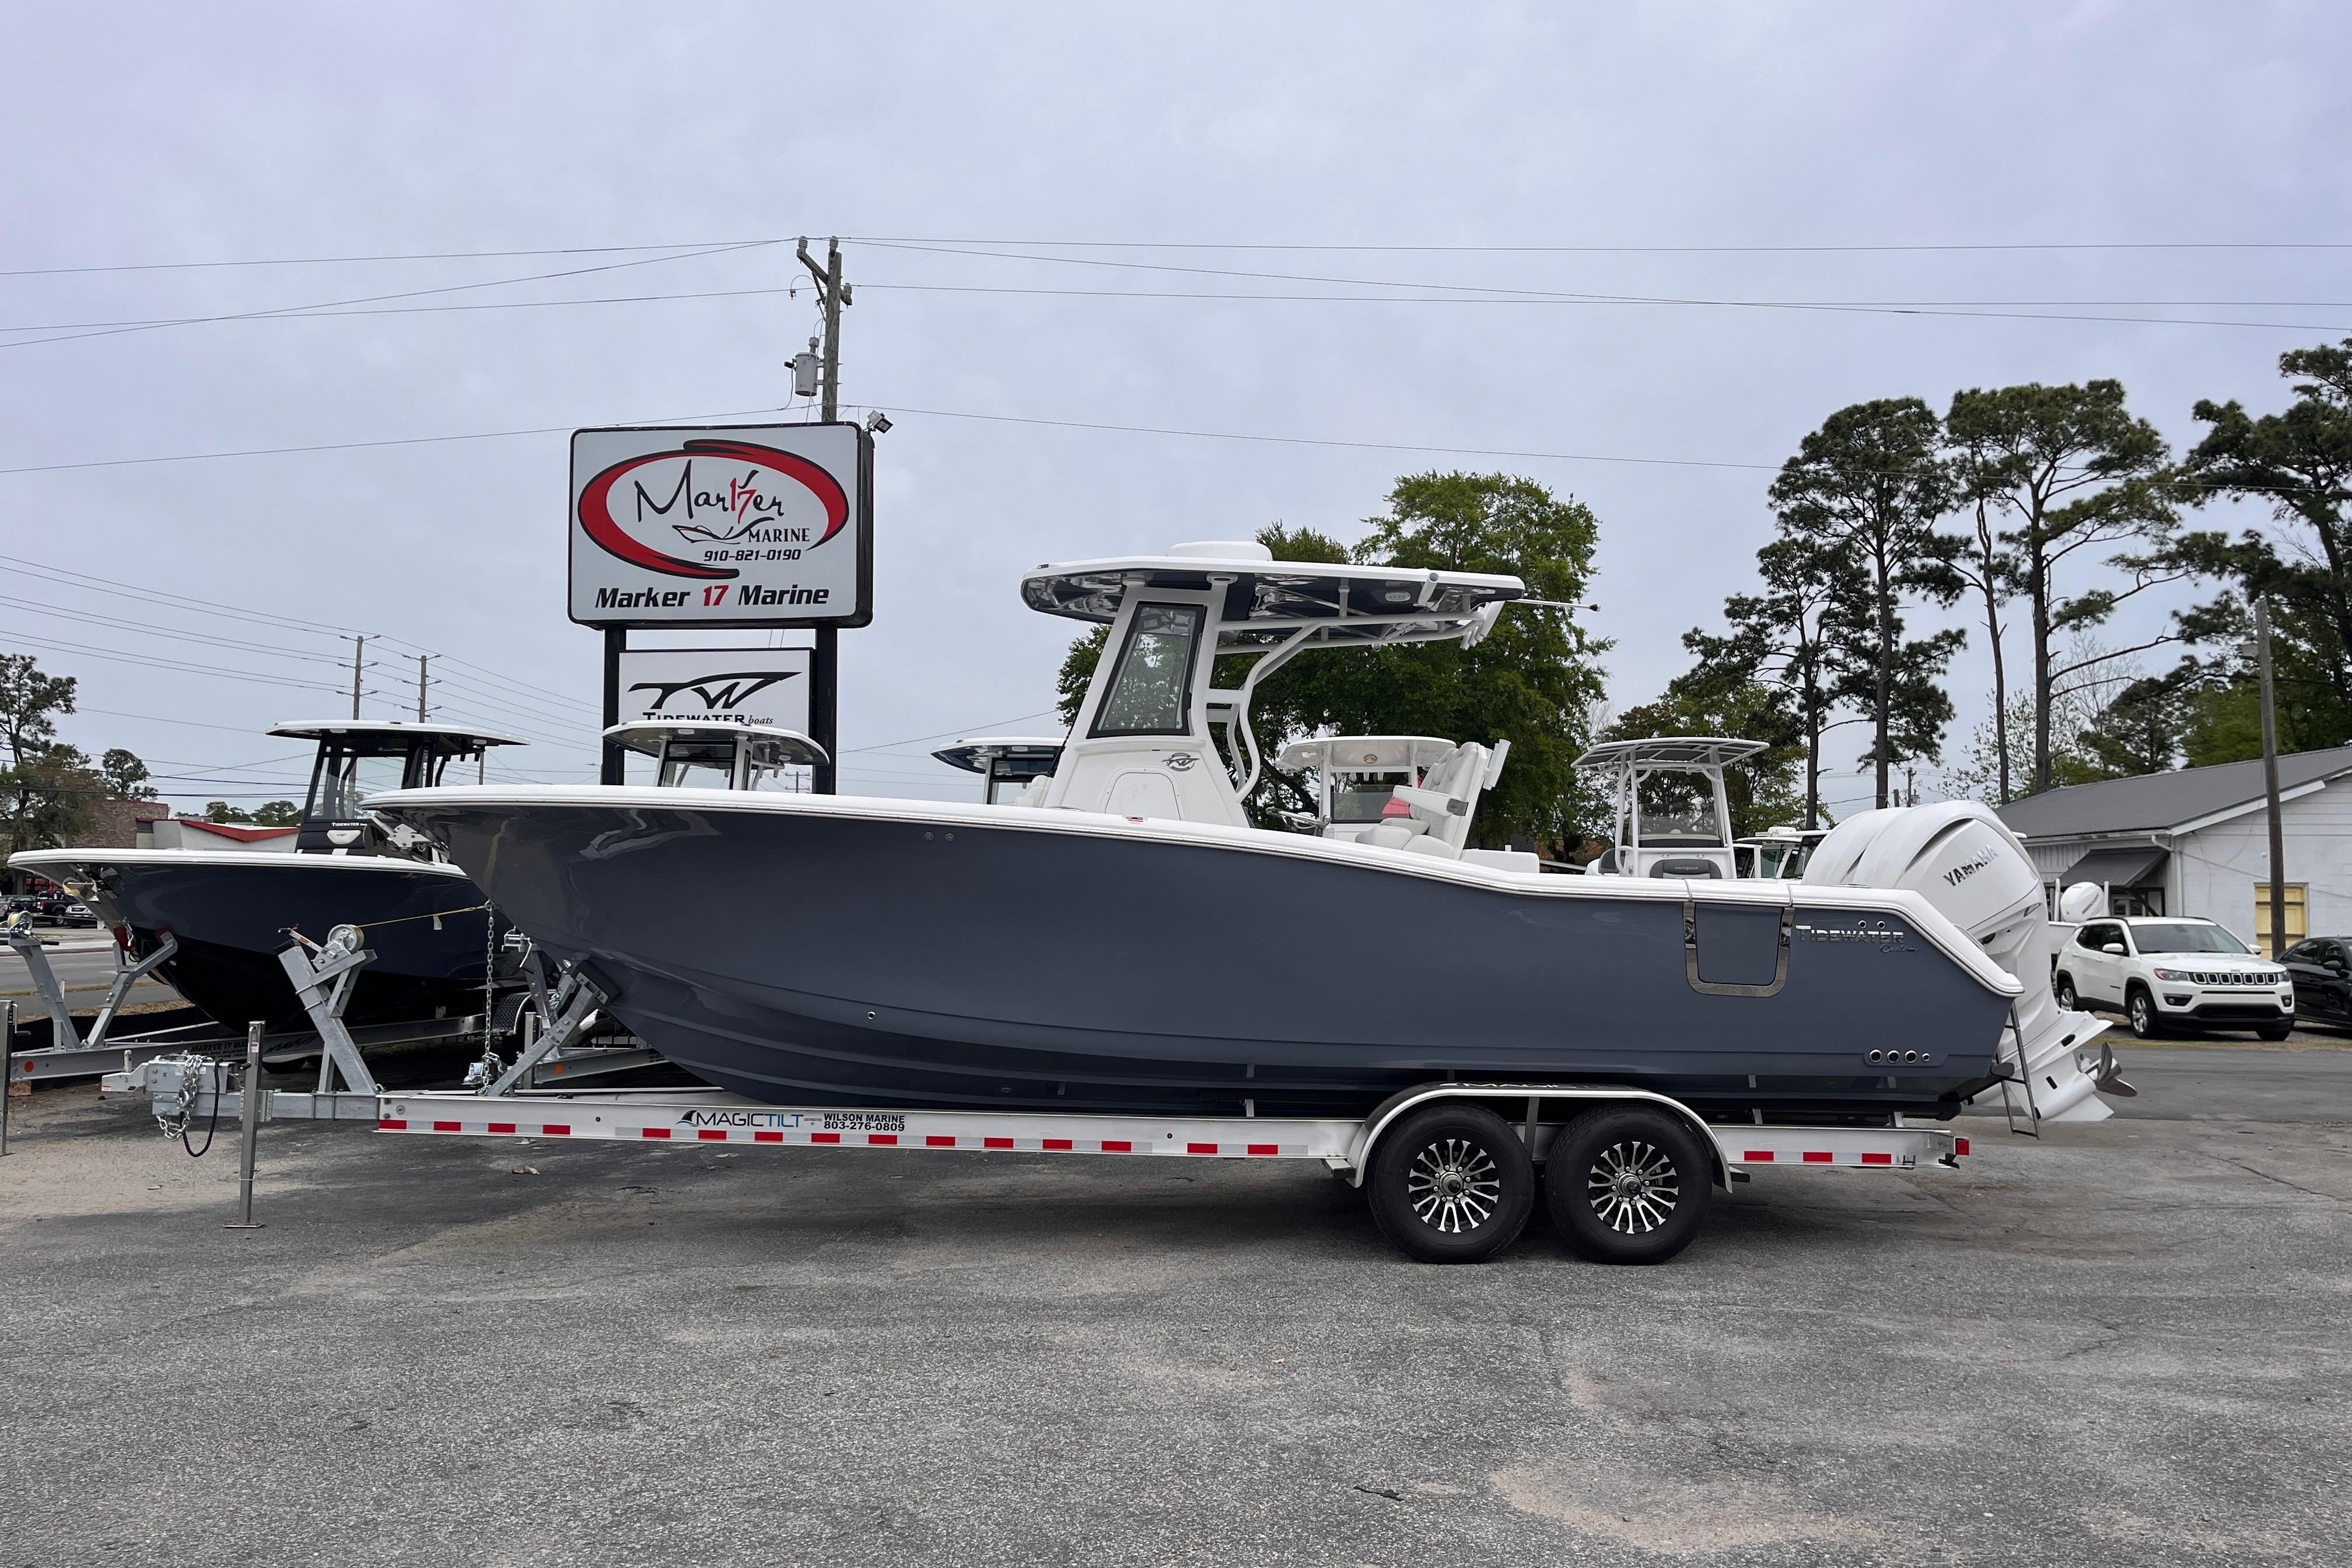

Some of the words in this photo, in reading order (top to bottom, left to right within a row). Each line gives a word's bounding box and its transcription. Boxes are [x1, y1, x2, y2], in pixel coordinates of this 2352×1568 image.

[748, 528, 810, 542] MARINE
[704, 549, 802, 562] 910-821-0190
[595, 587, 691, 608] Marker
[703, 585, 729, 607] 17
[738, 584, 830, 606] Marine
[748, 715, 774, 724] boats
[1943, 844, 1999, 887] YAMAHA
[1795, 925, 1905, 944] TIDEWATER
[824, 1112, 863, 1122] WILSON
[866, 1114, 905, 1124] MARINE
[824, 1121, 905, 1132] 803-276-0809
